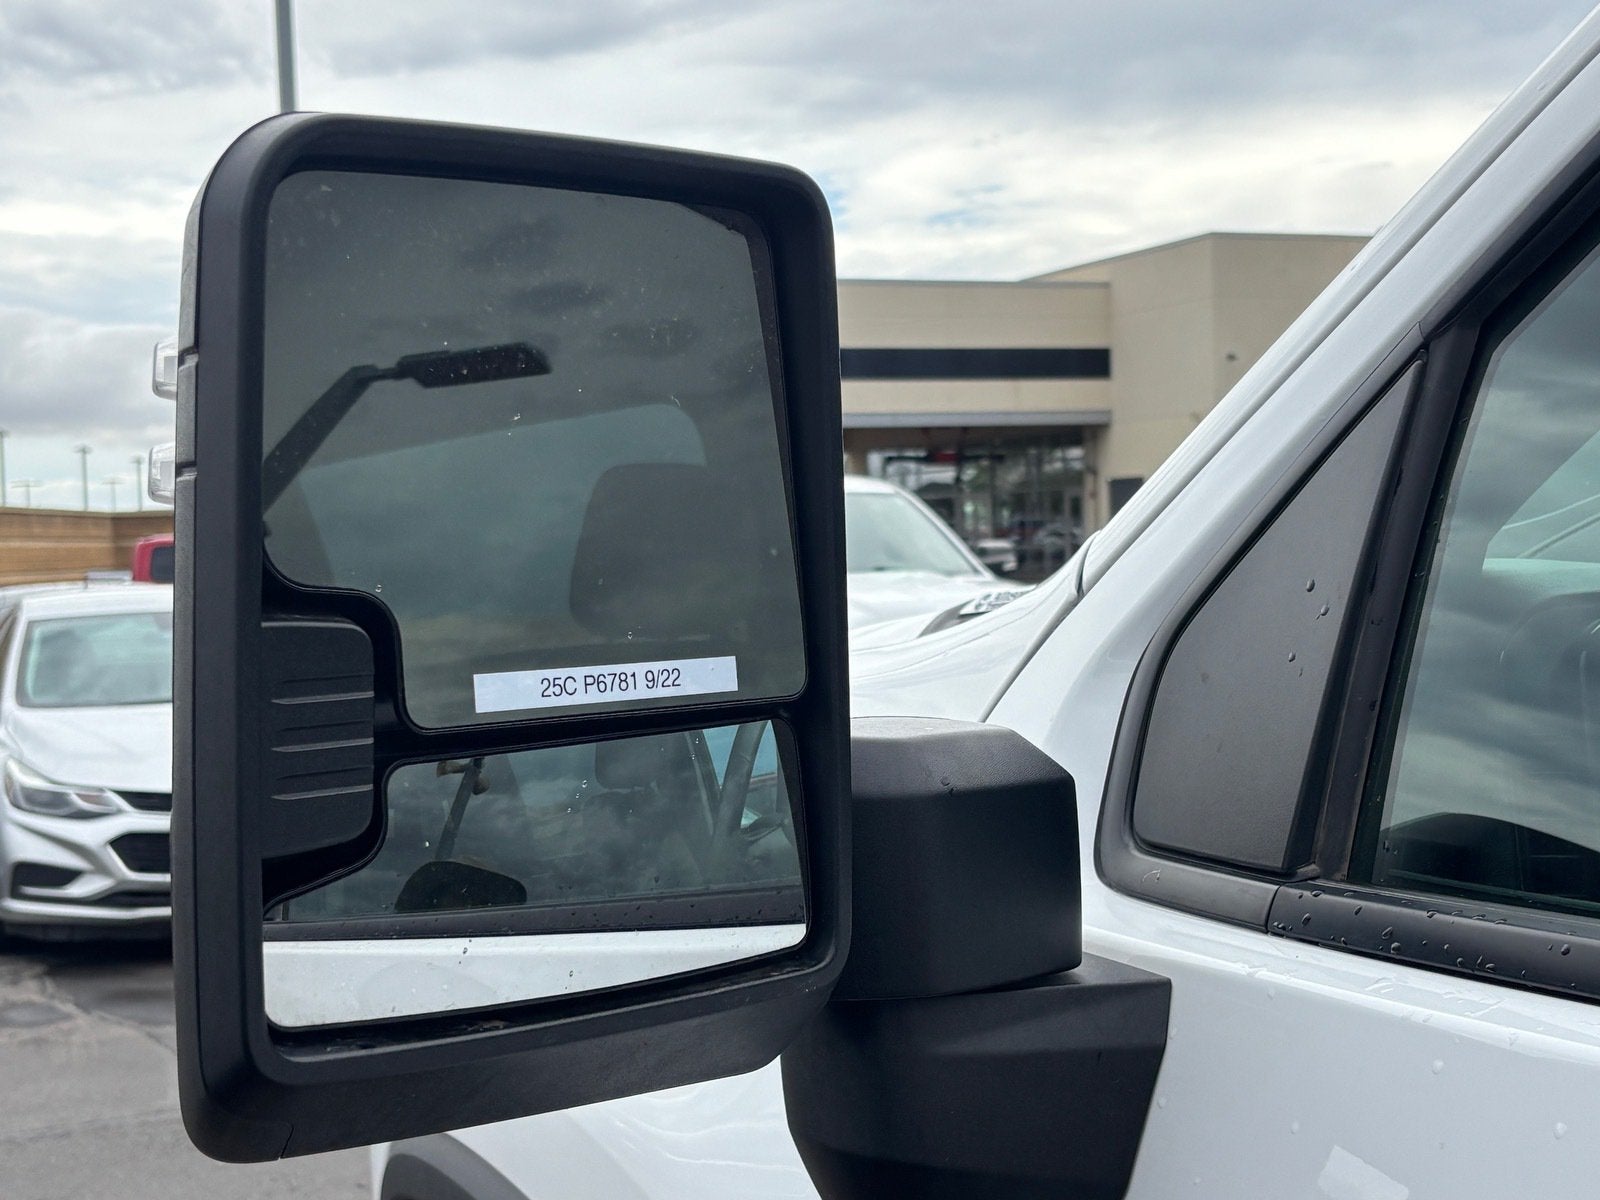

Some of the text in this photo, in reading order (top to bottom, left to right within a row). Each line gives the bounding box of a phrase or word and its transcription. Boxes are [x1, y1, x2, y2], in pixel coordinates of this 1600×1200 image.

[540, 668, 681, 698] 25C P6781 9/22
